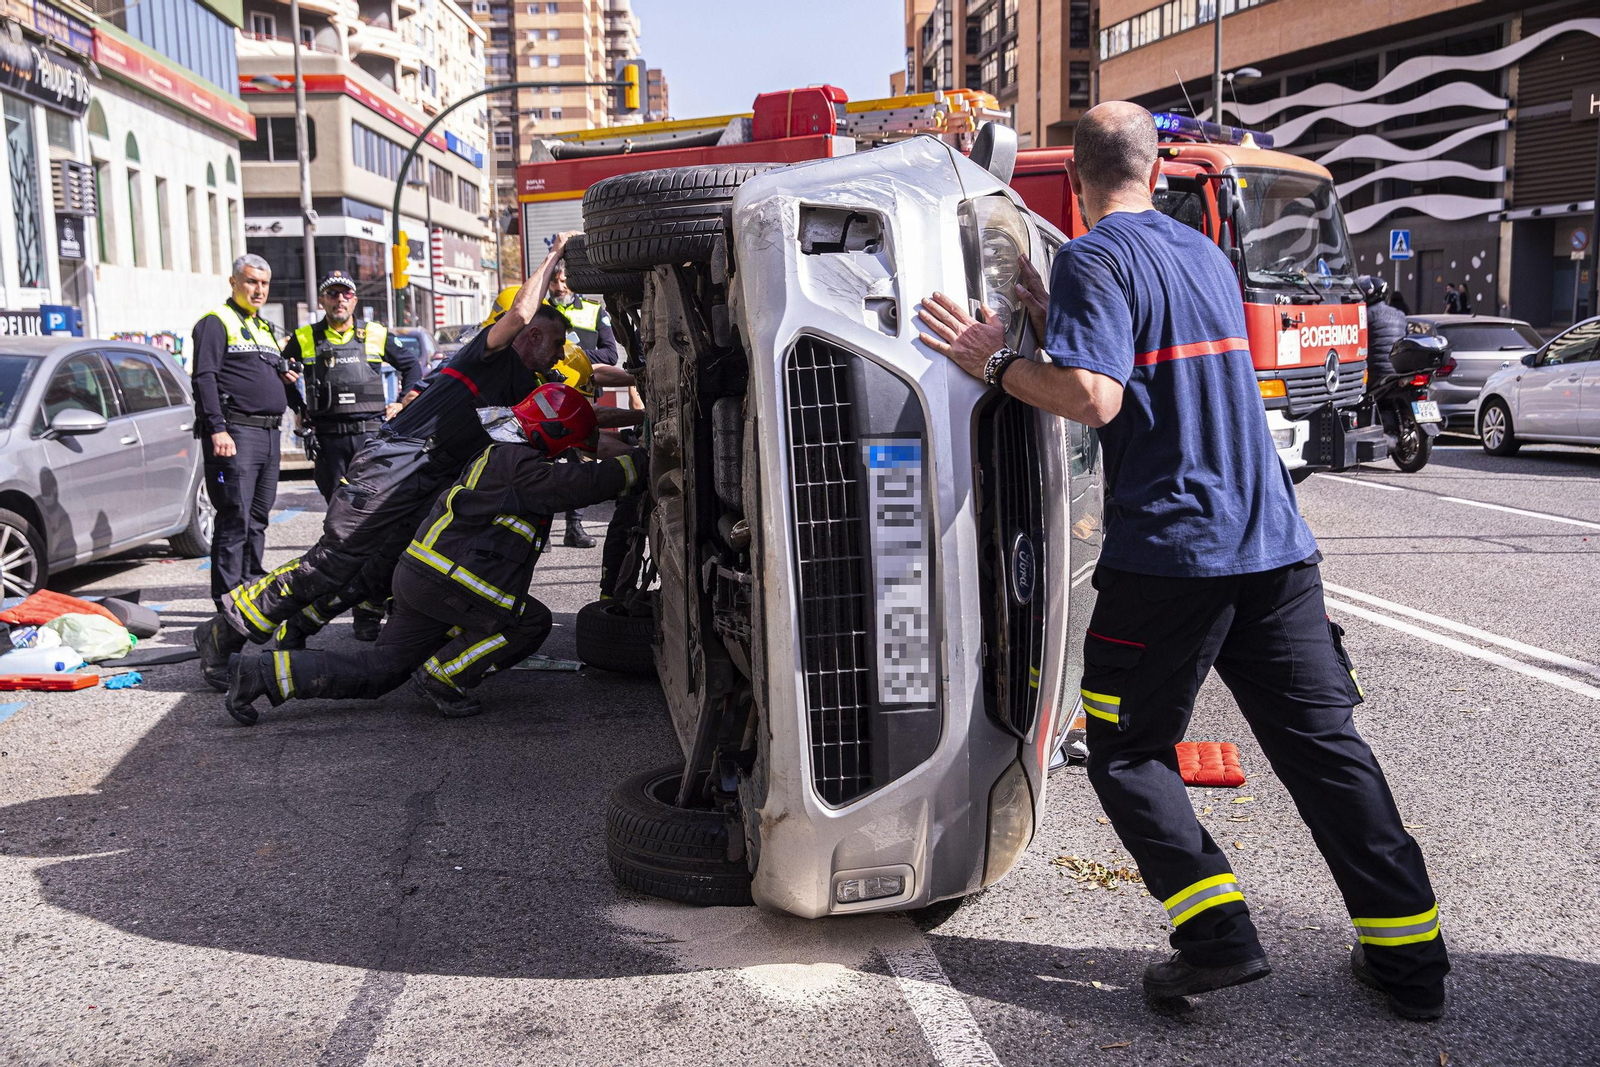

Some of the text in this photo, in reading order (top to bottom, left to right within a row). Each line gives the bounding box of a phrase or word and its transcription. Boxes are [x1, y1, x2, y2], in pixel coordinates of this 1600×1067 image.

[49, 313, 63, 330] P
[335, 355, 360, 365] POLICÍA
[1018, 550, 1032, 588] Ford
